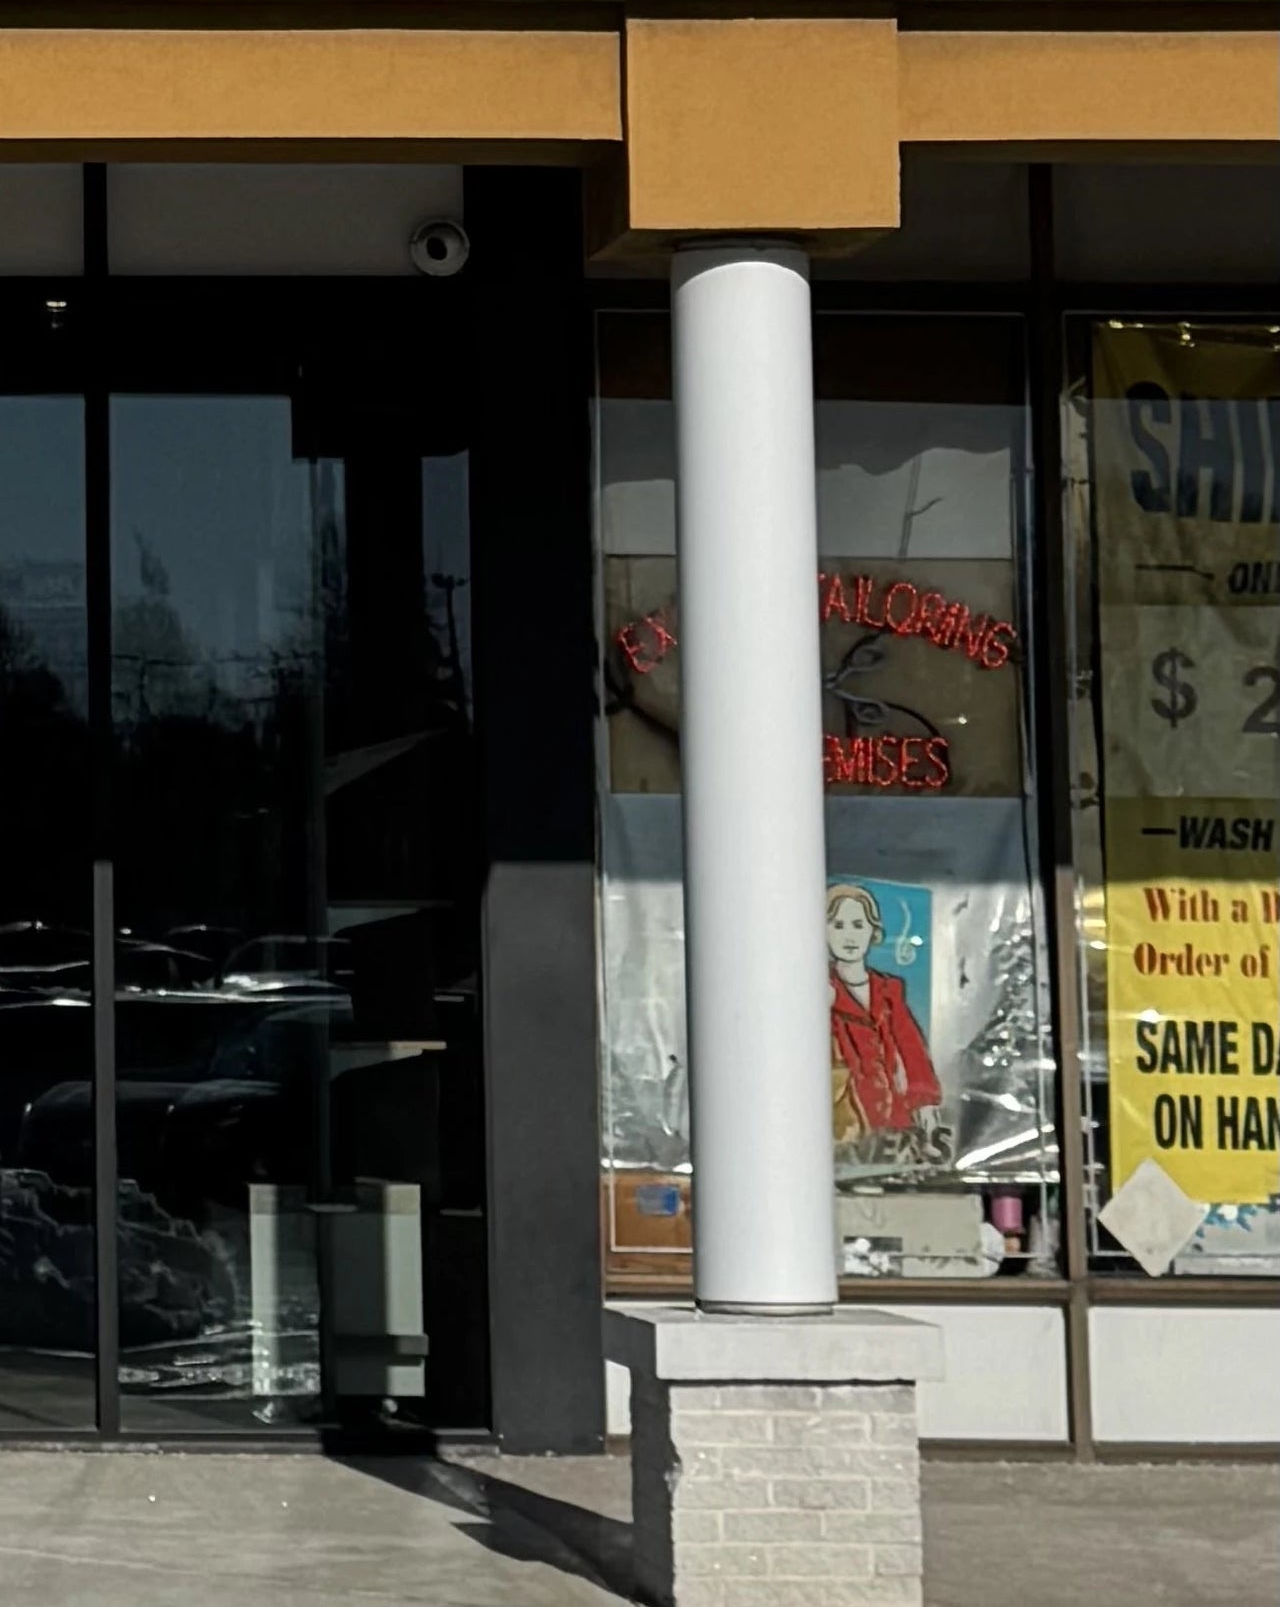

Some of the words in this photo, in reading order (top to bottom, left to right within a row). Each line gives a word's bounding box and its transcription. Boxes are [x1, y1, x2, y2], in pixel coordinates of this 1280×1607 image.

[1228, 560, 1280, 594] ON
[818, 571, 1018, 670] AILORING
[1143, 887, 1220, 923] With
[1231, 899, 1249, 924] a
[1133, 942, 1230, 978] Order
[1240, 944, 1271, 979] of
[1136, 1020, 1239, 1075] SAME
[1251, 1021, 1280, 1076] D
[1154, 1094, 1204, 1150] ON
